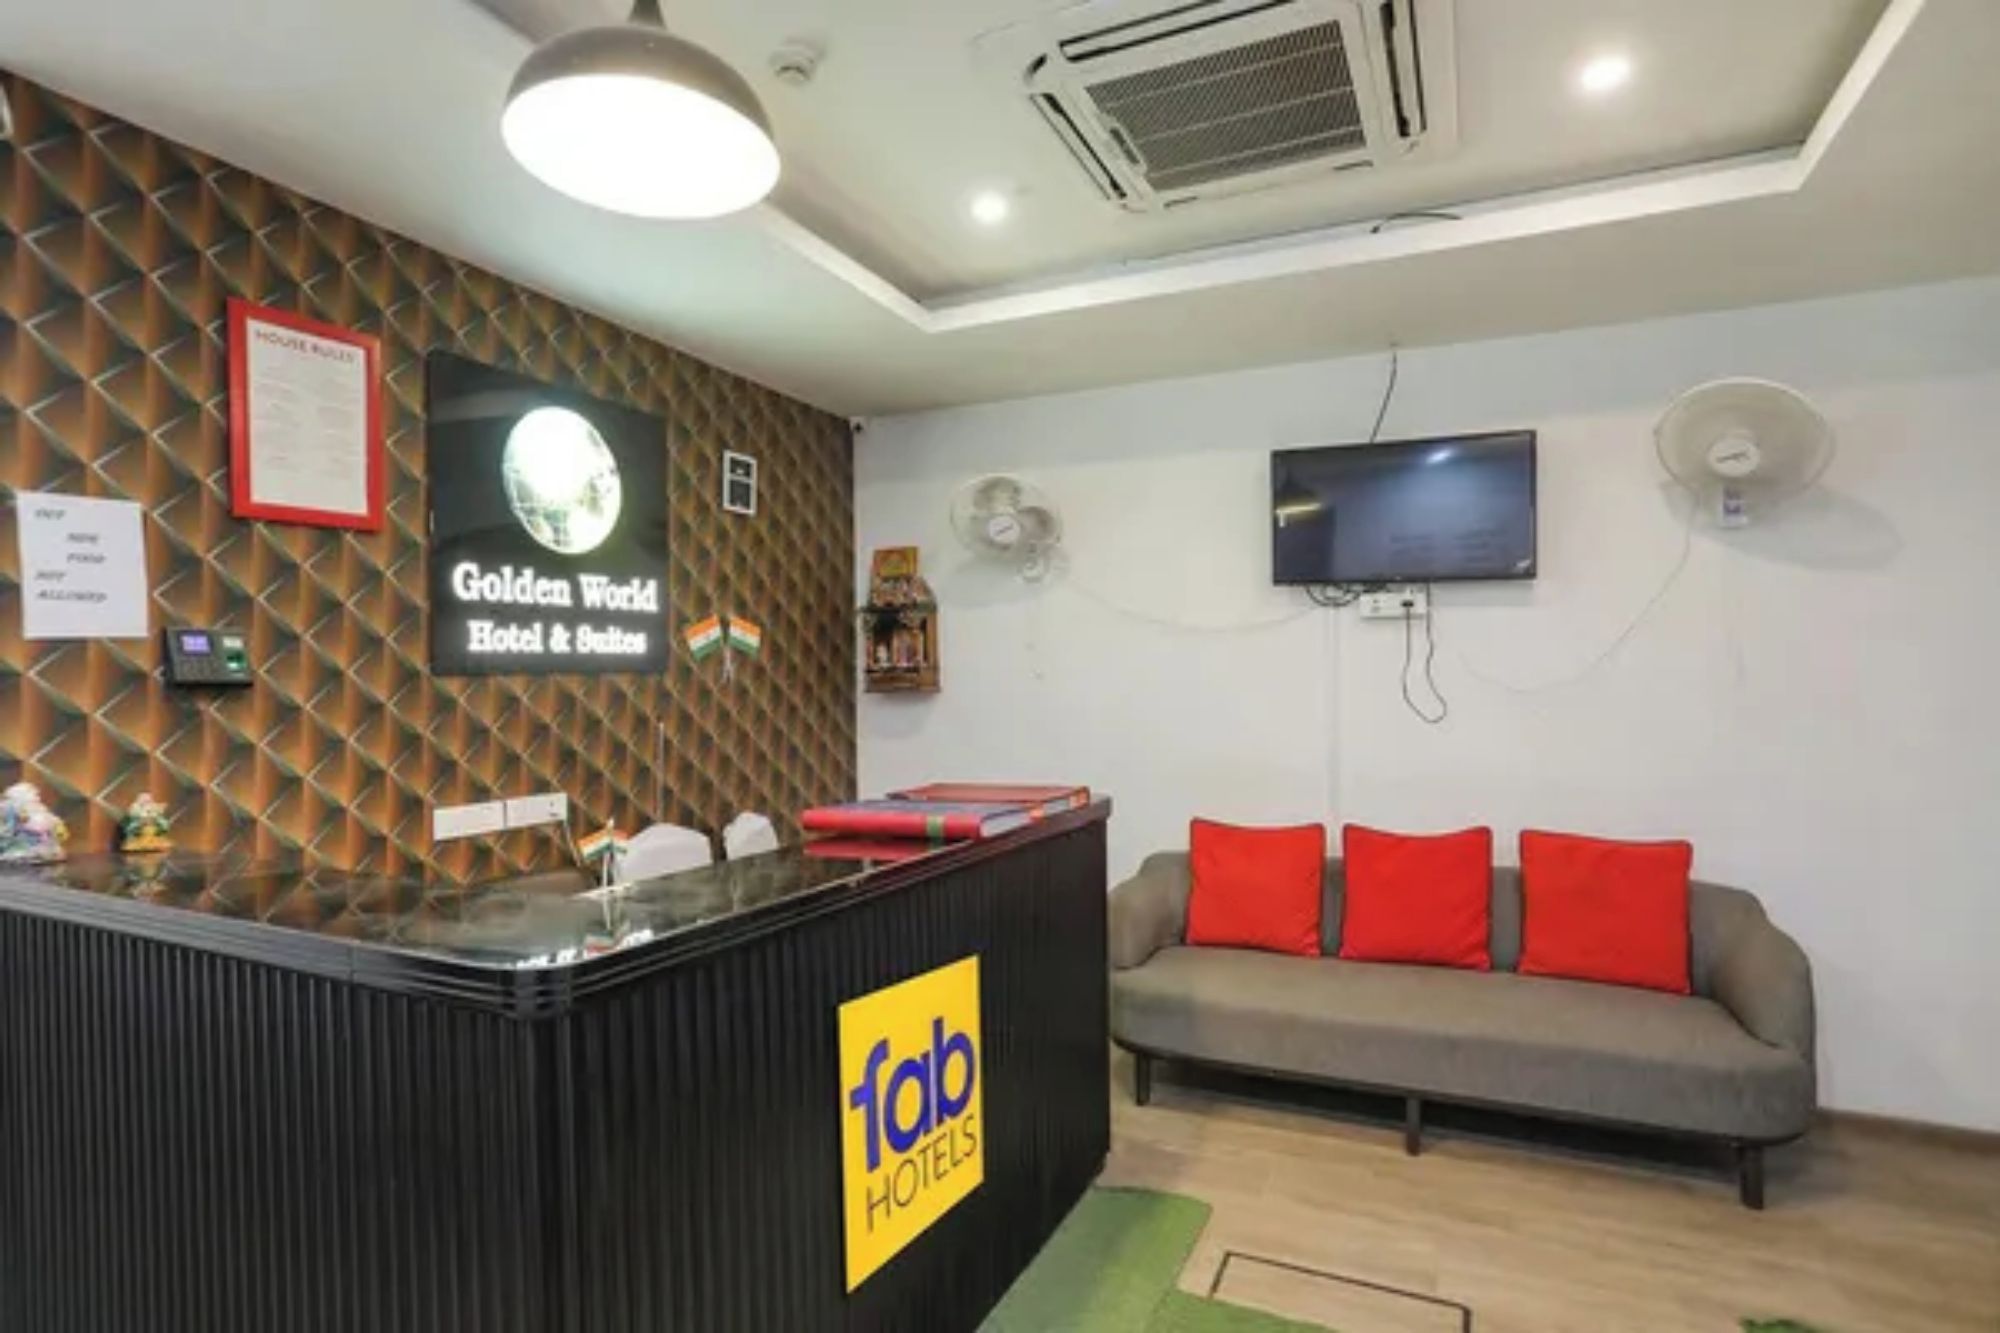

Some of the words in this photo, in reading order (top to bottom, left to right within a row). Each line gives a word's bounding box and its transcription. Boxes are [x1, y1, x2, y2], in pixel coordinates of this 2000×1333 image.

[452, 560, 574, 608] Golden
[577, 573, 659, 613] World
[466, 619, 544, 654] Hotel
[549, 621, 571, 654] &
[575, 624, 648, 655] Suites
[850, 1015, 976, 1174] fab
[866, 1113, 978, 1234] HOTELS
